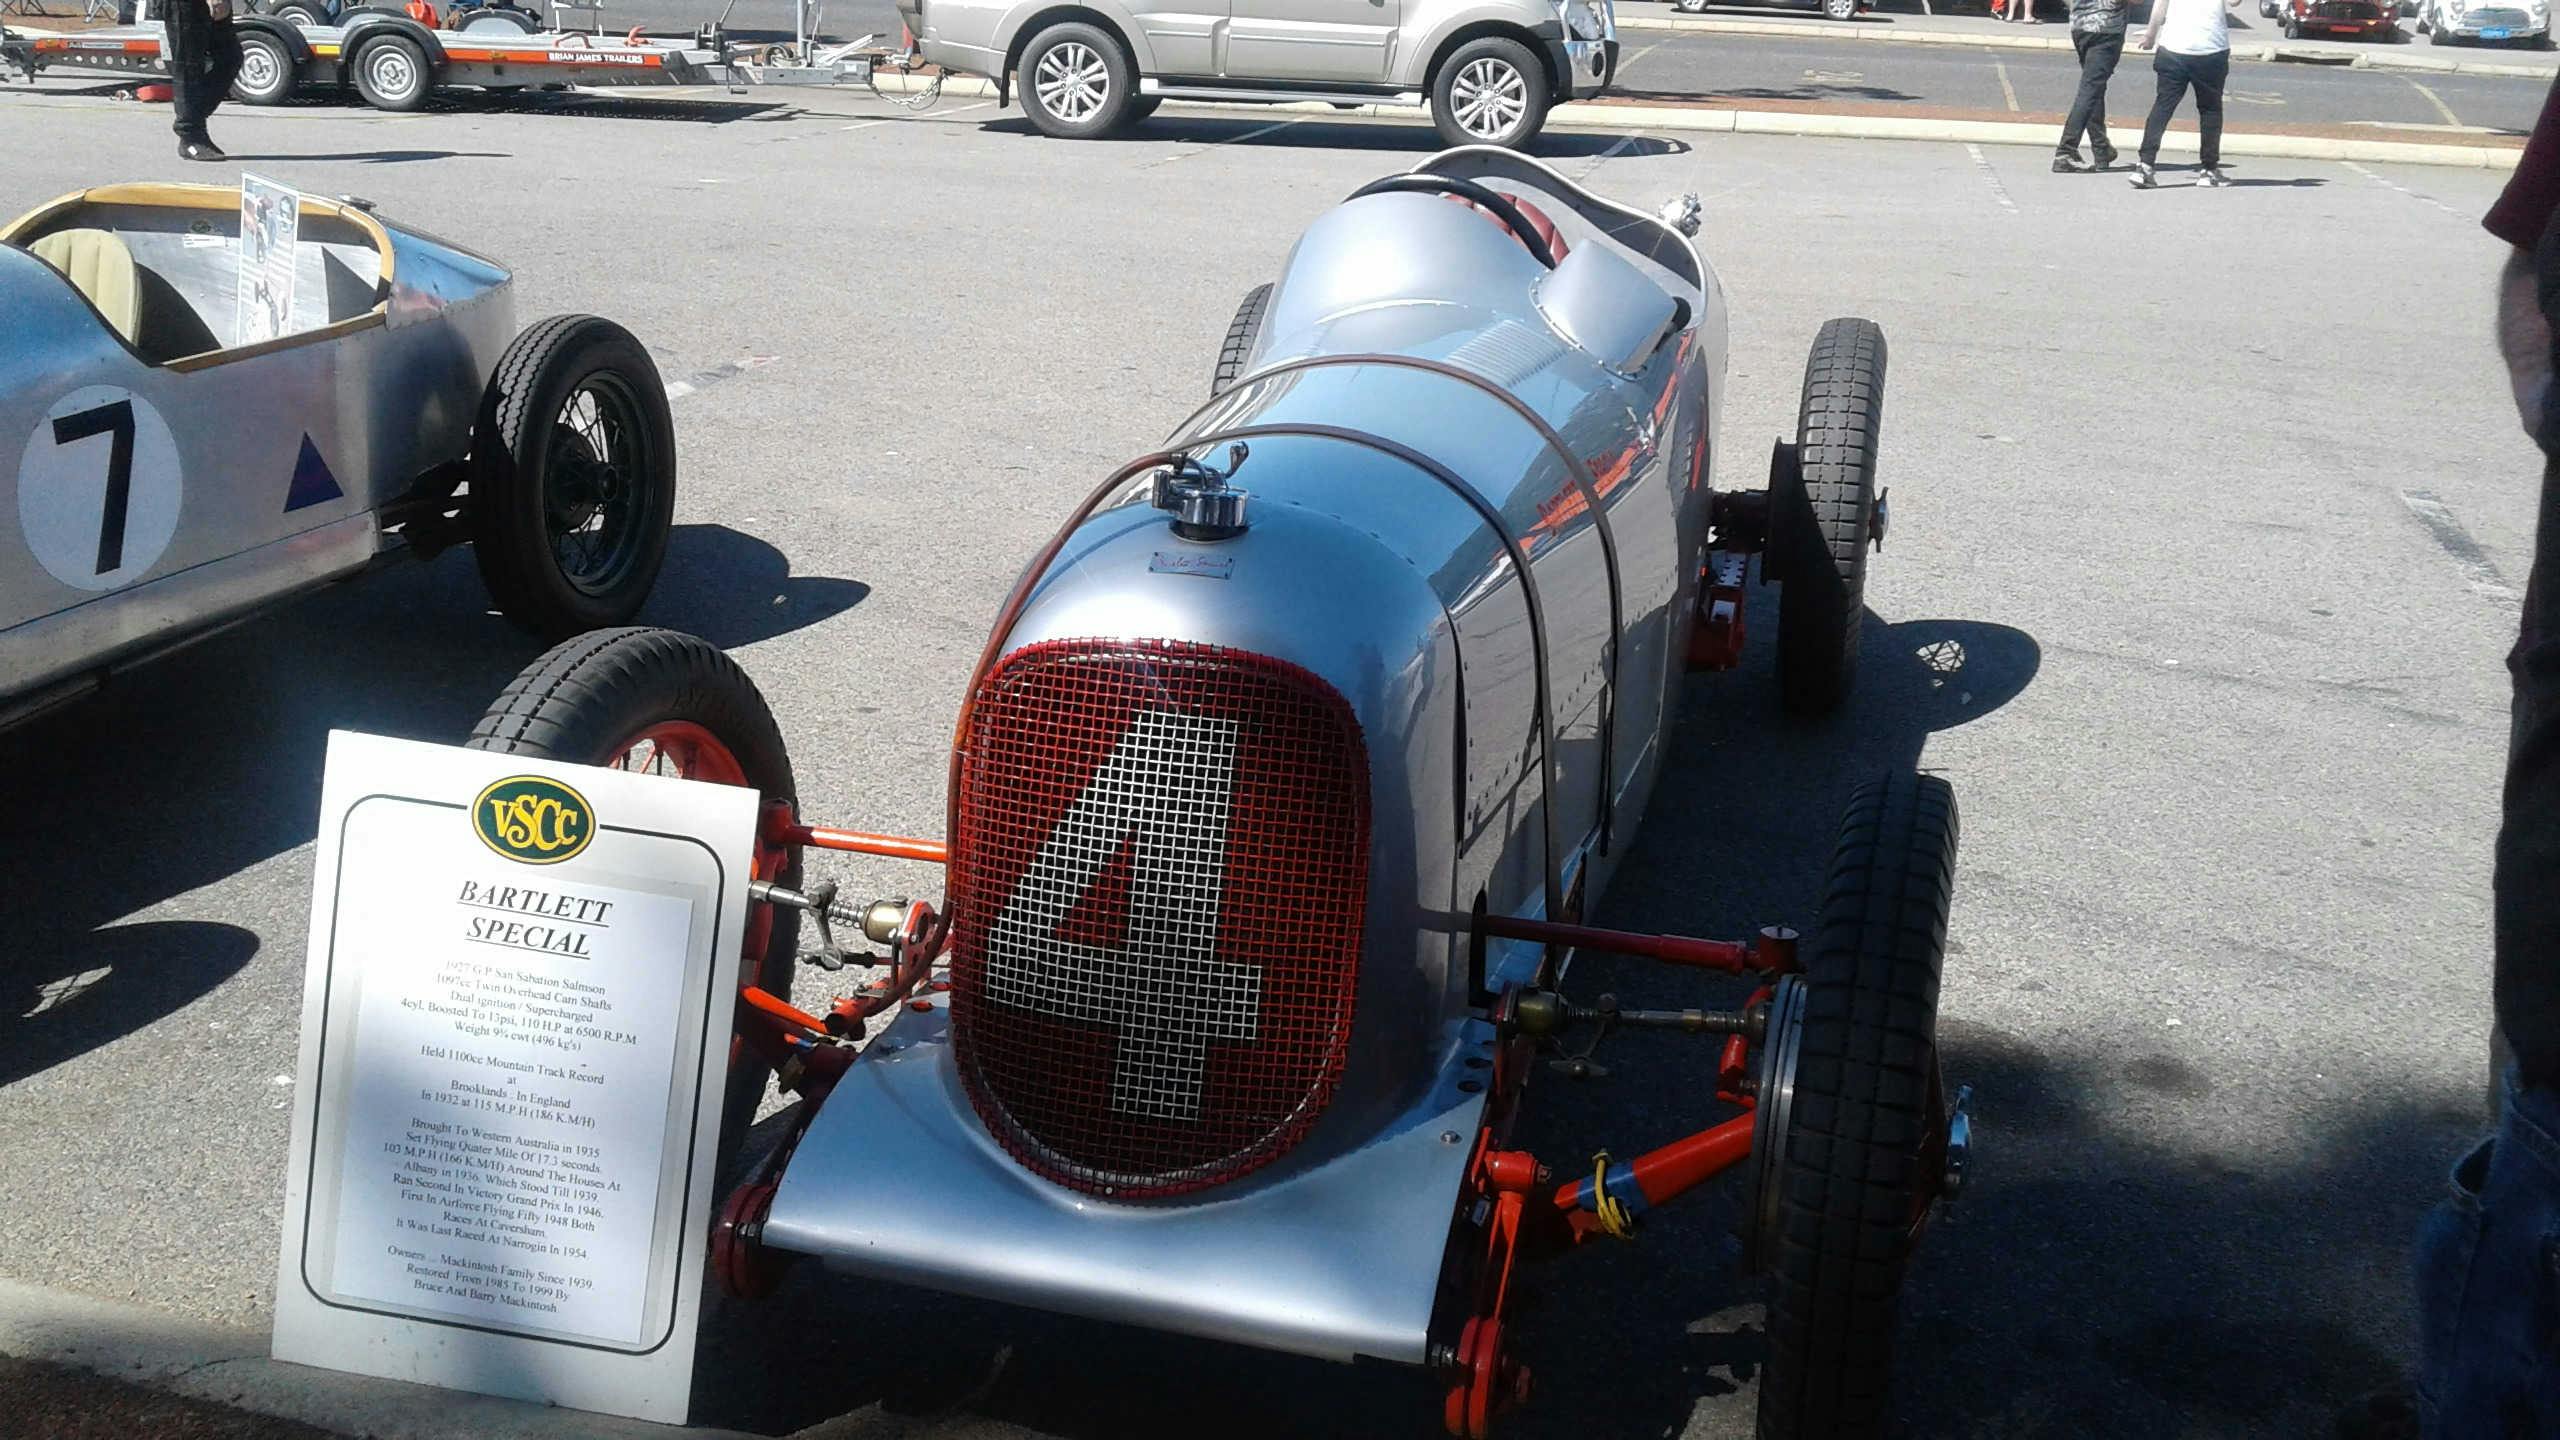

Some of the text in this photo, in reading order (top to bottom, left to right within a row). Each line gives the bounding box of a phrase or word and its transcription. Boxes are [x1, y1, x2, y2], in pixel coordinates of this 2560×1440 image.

[548, 51, 644, 64] BRIAN JAMES TRAILERS
[52, 399, 135, 575] 7
[490, 794, 578, 851] VSCC
[458, 880, 613, 924] BARTLETT
[986, 708, 1263, 1121] 4
[466, 916, 591, 956] SPECIAL
[475, 979, 500, 992] Twin
[503, 984, 551, 1001] Overhead
[554, 992, 577, 1005] Cam
[580, 997, 611, 1011] Shafts
[494, 968, 512, 979] San
[563, 979, 605, 994] Salmson
[428, 1001, 468, 1017] Boosted
[472, 1009, 486, 1020] To
[521, 1017, 539, 1029] 110
[564, 1025, 574, 1035] at
[576, 1026, 602, 1039] 6500
[451, 990, 473, 1002] Dual
[525, 1003, 593, 1023] Supercharged
[455, 1021, 490, 1036] Weight
[532, 1033, 555, 1048] (496
[421, 1045, 604, 1085] Held 1100cc Mountain Track Record
[506, 1076, 517, 1085] at
[421, 1088, 431, 1100] In
[474, 1097, 491, 1110] 115
[530, 1107, 553, 1122] (186
[451, 1079, 571, 1110] Brooklands In England
[412, 1117, 600, 1159] Brought To Western Australia in 1935
[496, 1146, 518, 1159] Mile
[521, 1150, 534, 1162] Of
[393, 1173, 413, 1186] Ran
[416, 1177, 450, 1192] Second
[454, 1183, 464, 1194] In
[468, 1186, 501, 1203] Victory
[507, 1192, 537, 1207] Grand
[541, 1198, 560, 1211] Prix
[564, 1202, 574, 1213] In
[404, 1160, 437, 1176] Albany
[442, 1168, 451, 1177] in
[486, 1174, 517, 1189] Which
[521, 1180, 549, 1194] Stood
[553, 1186, 570, 1198] Till
[507, 1163, 544, 1179] Around
[548, 1170, 566, 1182] The
[569, 1174, 605, 1189] Houses
[610, 1181, 621, 1192] At
[402, 1189, 595, 1231] First In Airforce Flying Fifty 1948 Both
[443, 1211, 472, 1225] Races
[477, 1216, 488, 1227] At
[408, 1219, 428, 1232] Was
[431, 1223, 451, 1236] Last
[455, 1227, 485, 1242] Raced
[489, 1233, 500, 1244] At
[503, 1235, 546, 1253] Narrogin
[550, 1243, 560, 1255] In
[407, 1263, 449, 1280] Restored
[455, 1271, 482, 1285] From
[513, 1281, 526, 1293] To
[556, 1288, 570, 1302] By
[440, 1254, 498, 1273] Mackintosh
[501, 1264, 535, 1281] Family
[538, 1270, 565, 1284] Since
[414, 1279, 557, 1313] Bruce And Barry Mackintosh
